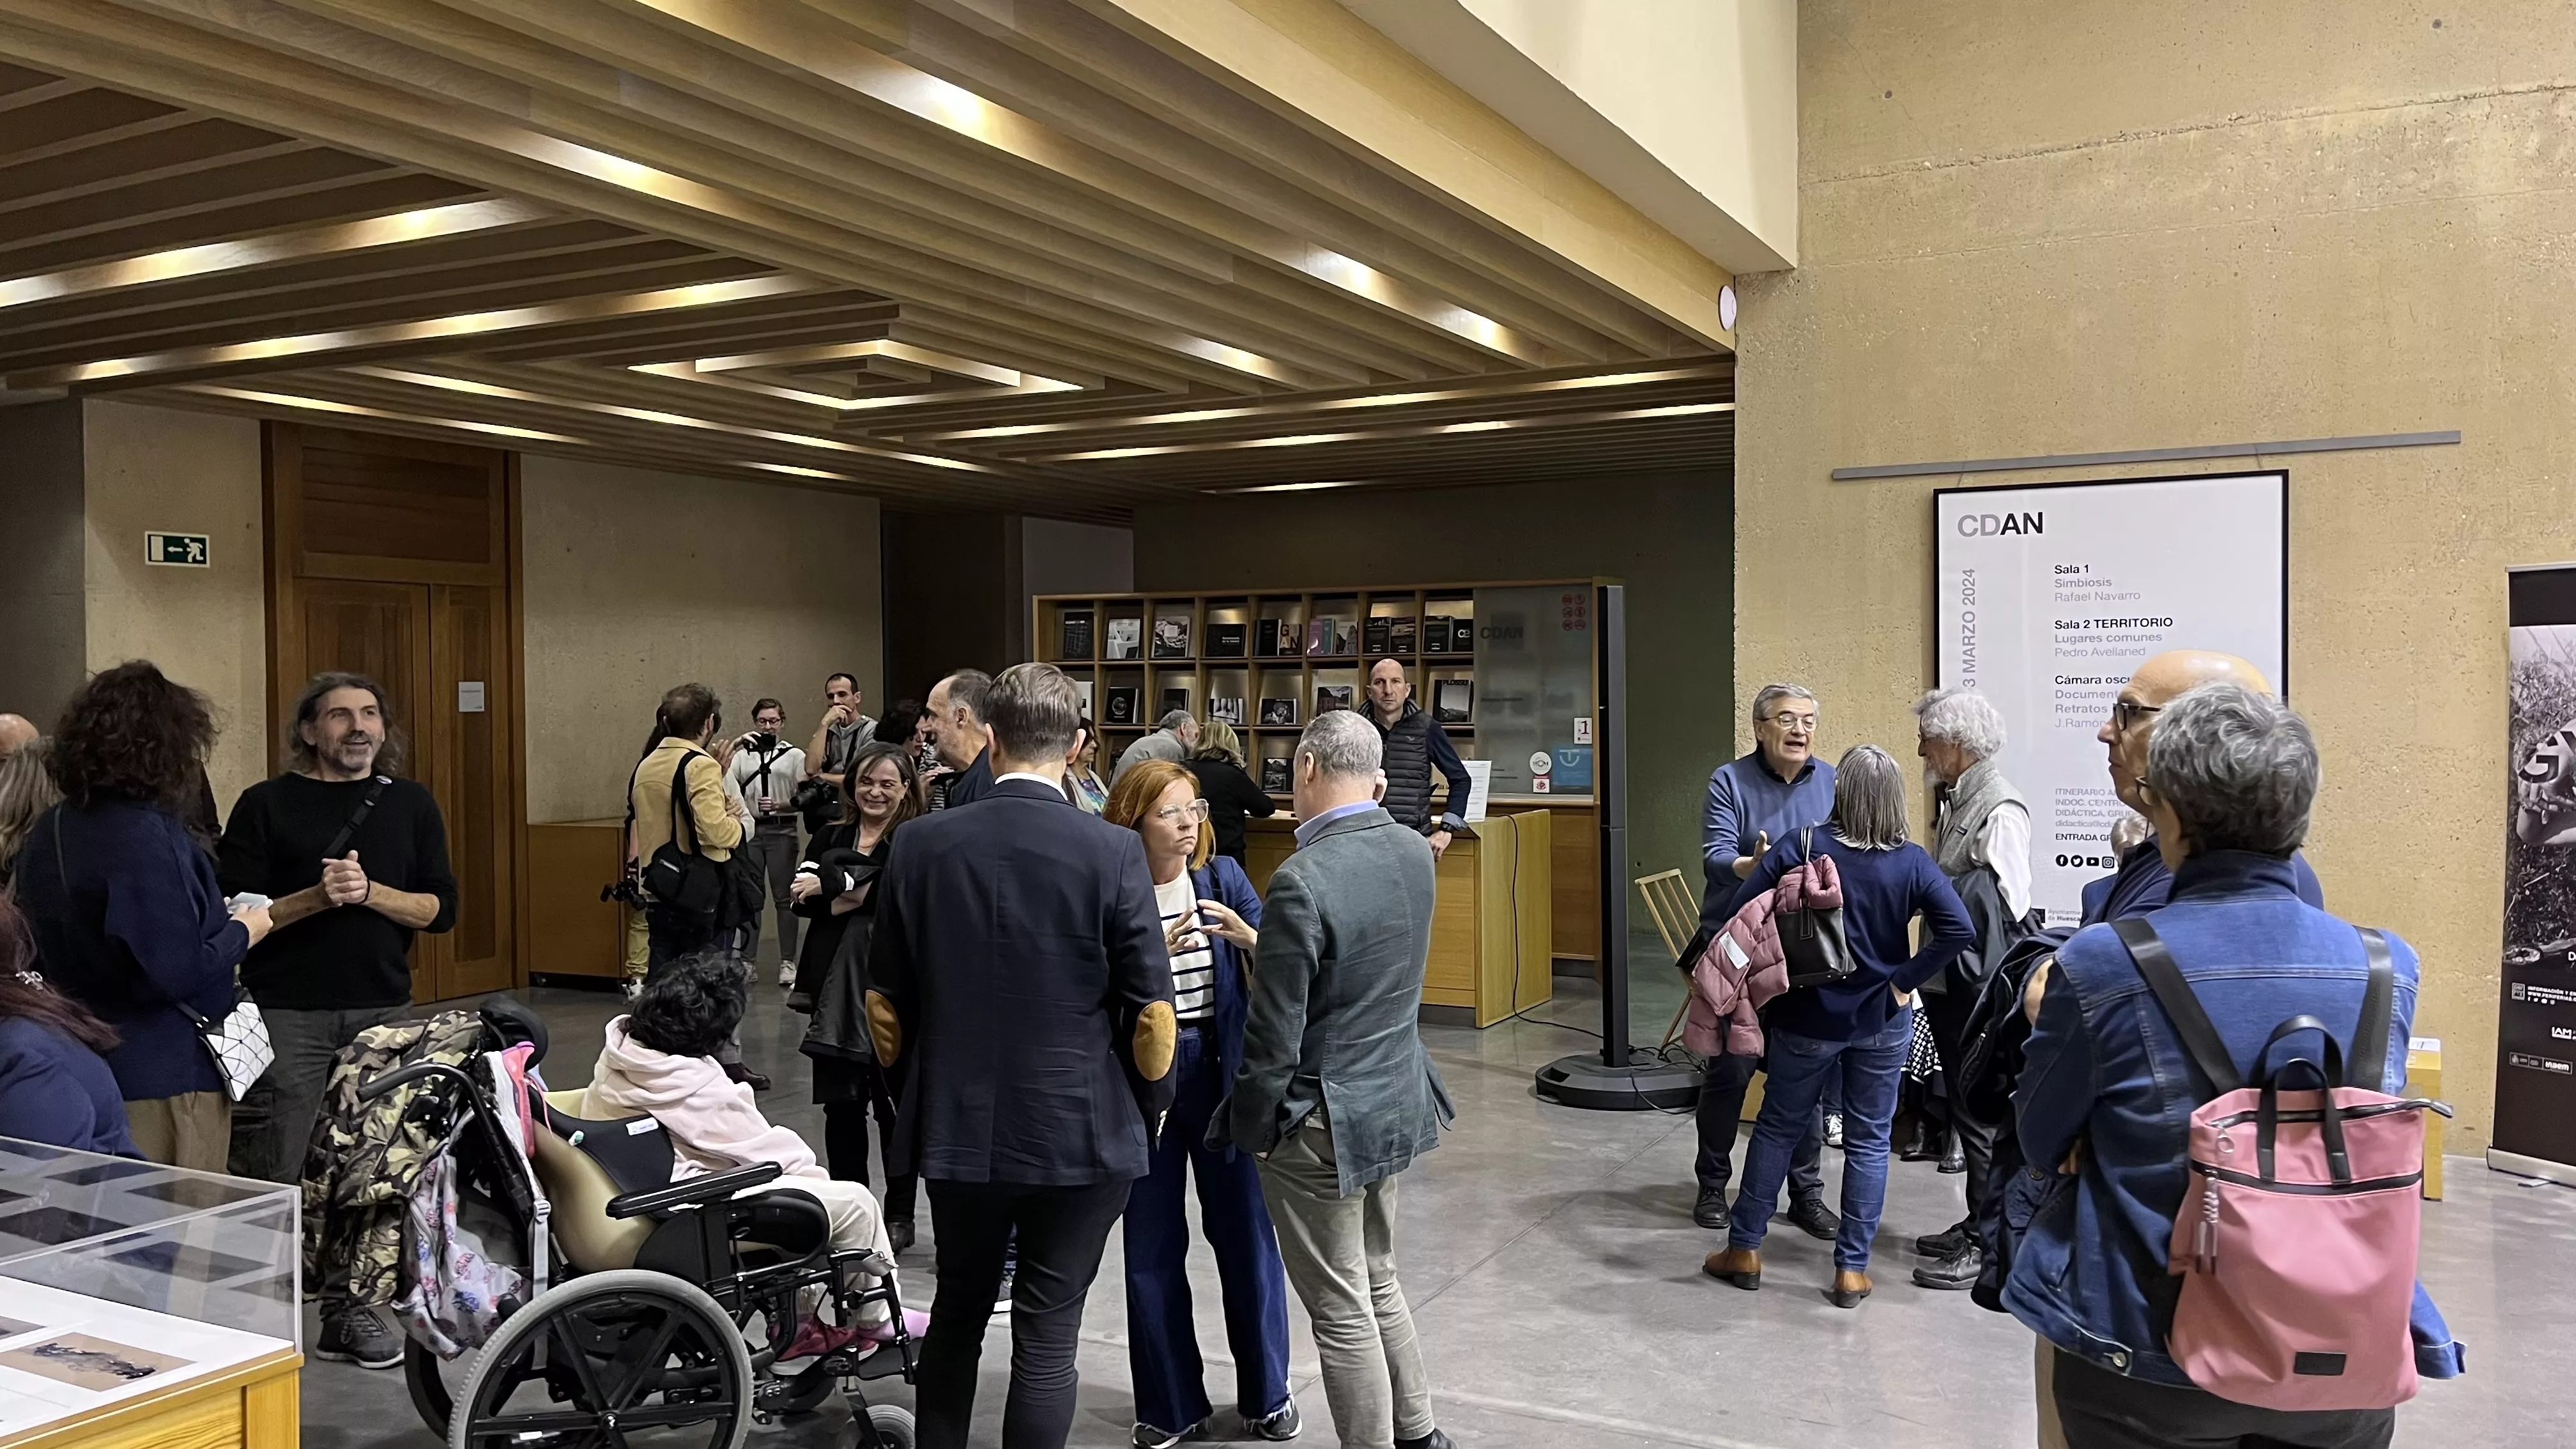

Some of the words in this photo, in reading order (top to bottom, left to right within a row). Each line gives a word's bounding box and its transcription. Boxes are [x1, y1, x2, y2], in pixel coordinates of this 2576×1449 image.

[1958, 512, 2043, 537] CDAN
[2054, 565, 2080, 574] Sala
[2083, 564, 2089, 573] 1
[1962, 568, 1975, 606] 2024
[2054, 578, 2112, 588] Simbiosis
[2055, 592, 2090, 602] Rafael
[2094, 591, 2141, 601] Navarro
[2054, 620, 2080, 629] Sala
[2083, 620, 2090, 629] 2
[2094, 617, 2173, 629] TERRITORIO
[1962, 611, 1975, 673] MARZO
[2055, 634, 2103, 645] Lugares
[2106, 633, 2163, 642] comunes
[2055, 647, 2088, 657] Pedro
[2090, 647, 2146, 657] Avellaned
[2055, 675, 2101, 684] Cámara
[2055, 703, 2108, 714] Retratos
[2055, 833, 2098, 841] ENTRADA
